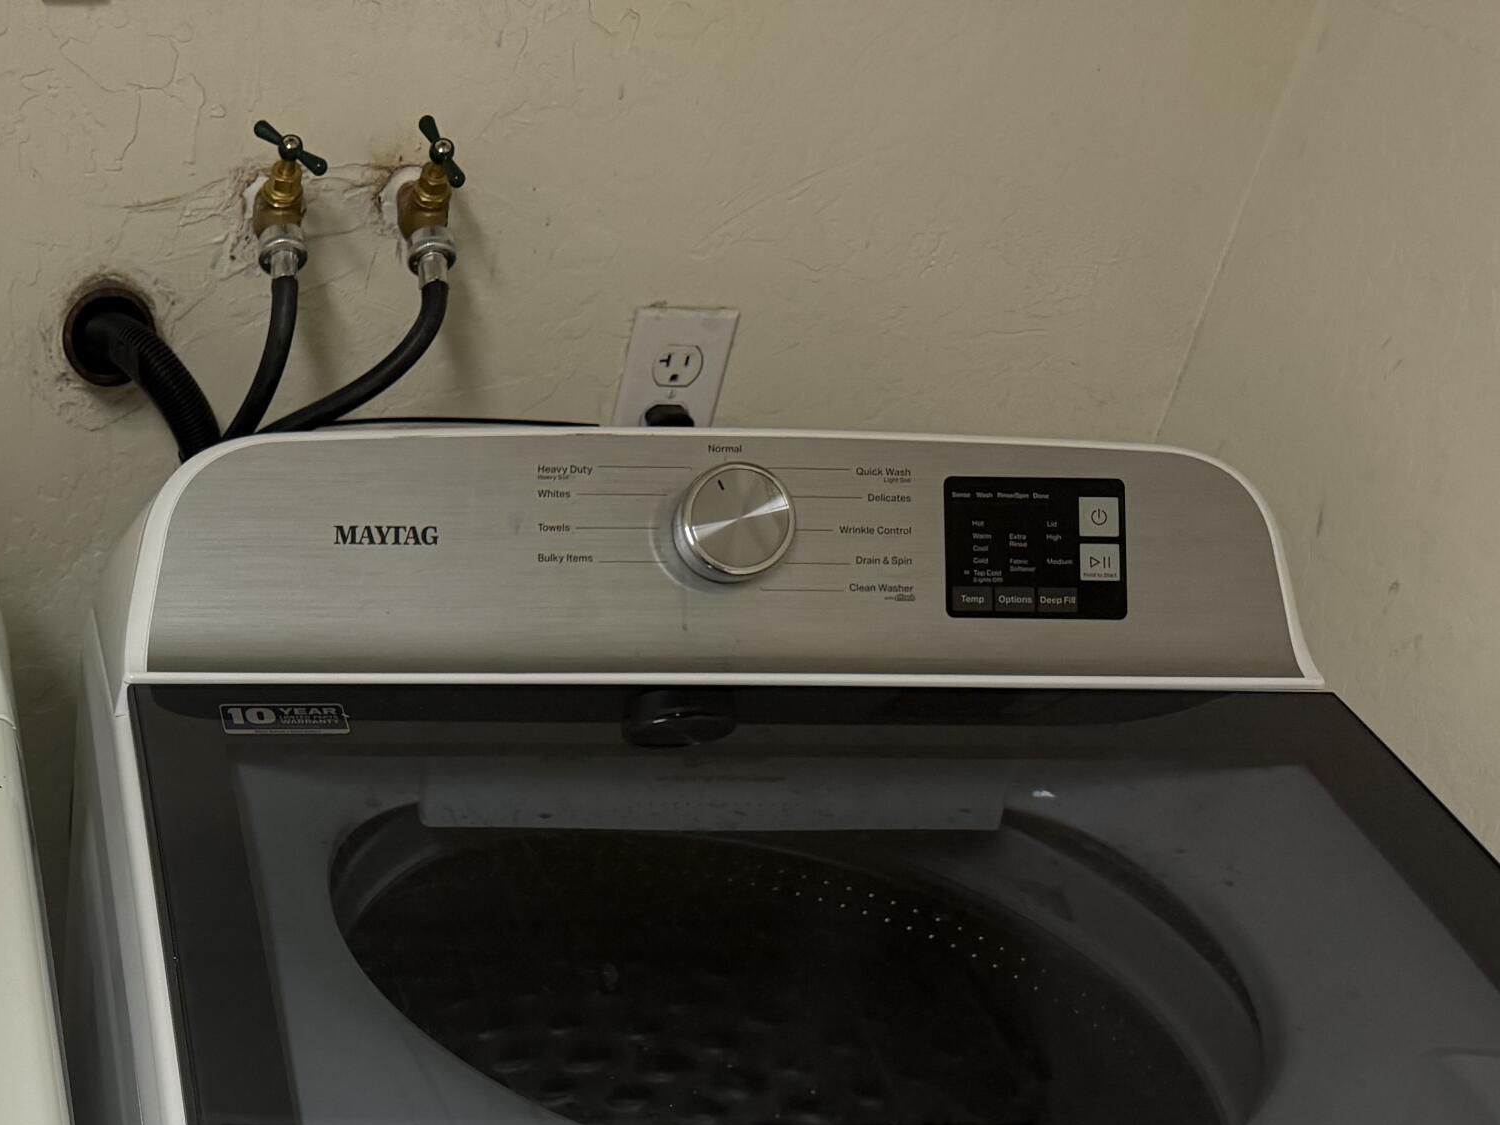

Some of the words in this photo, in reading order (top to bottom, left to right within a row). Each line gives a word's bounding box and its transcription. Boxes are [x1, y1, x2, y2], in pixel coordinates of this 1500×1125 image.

[707, 444, 742, 454] Normal
[537, 465, 567, 475] Heavy
[569, 465, 593, 475] Duty
[856, 467, 883, 478] Quick
[885, 468, 911, 477] Wash
[537, 489, 571, 499] Whites
[867, 493, 911, 503] Delicates
[537, 523, 570, 532] Towels
[839, 525, 875, 535] Wrinkle
[877, 525, 912, 535] Control
[333, 525, 440, 546] MAYTAG
[537, 553, 563, 564] Bulky
[565, 553, 593, 563] Items
[856, 556, 881, 565] Drain
[883, 556, 891, 565] &
[892, 556, 912, 568] Spin
[849, 583, 876, 593] Clean
[878, 583, 913, 593] Washer
[961, 595, 984, 603] Temp
[998, 595, 1032, 604] Options
[1040, 596, 1062, 604] Deep
[227, 708, 276, 725] 10
[279, 707, 337, 715] YEAR
